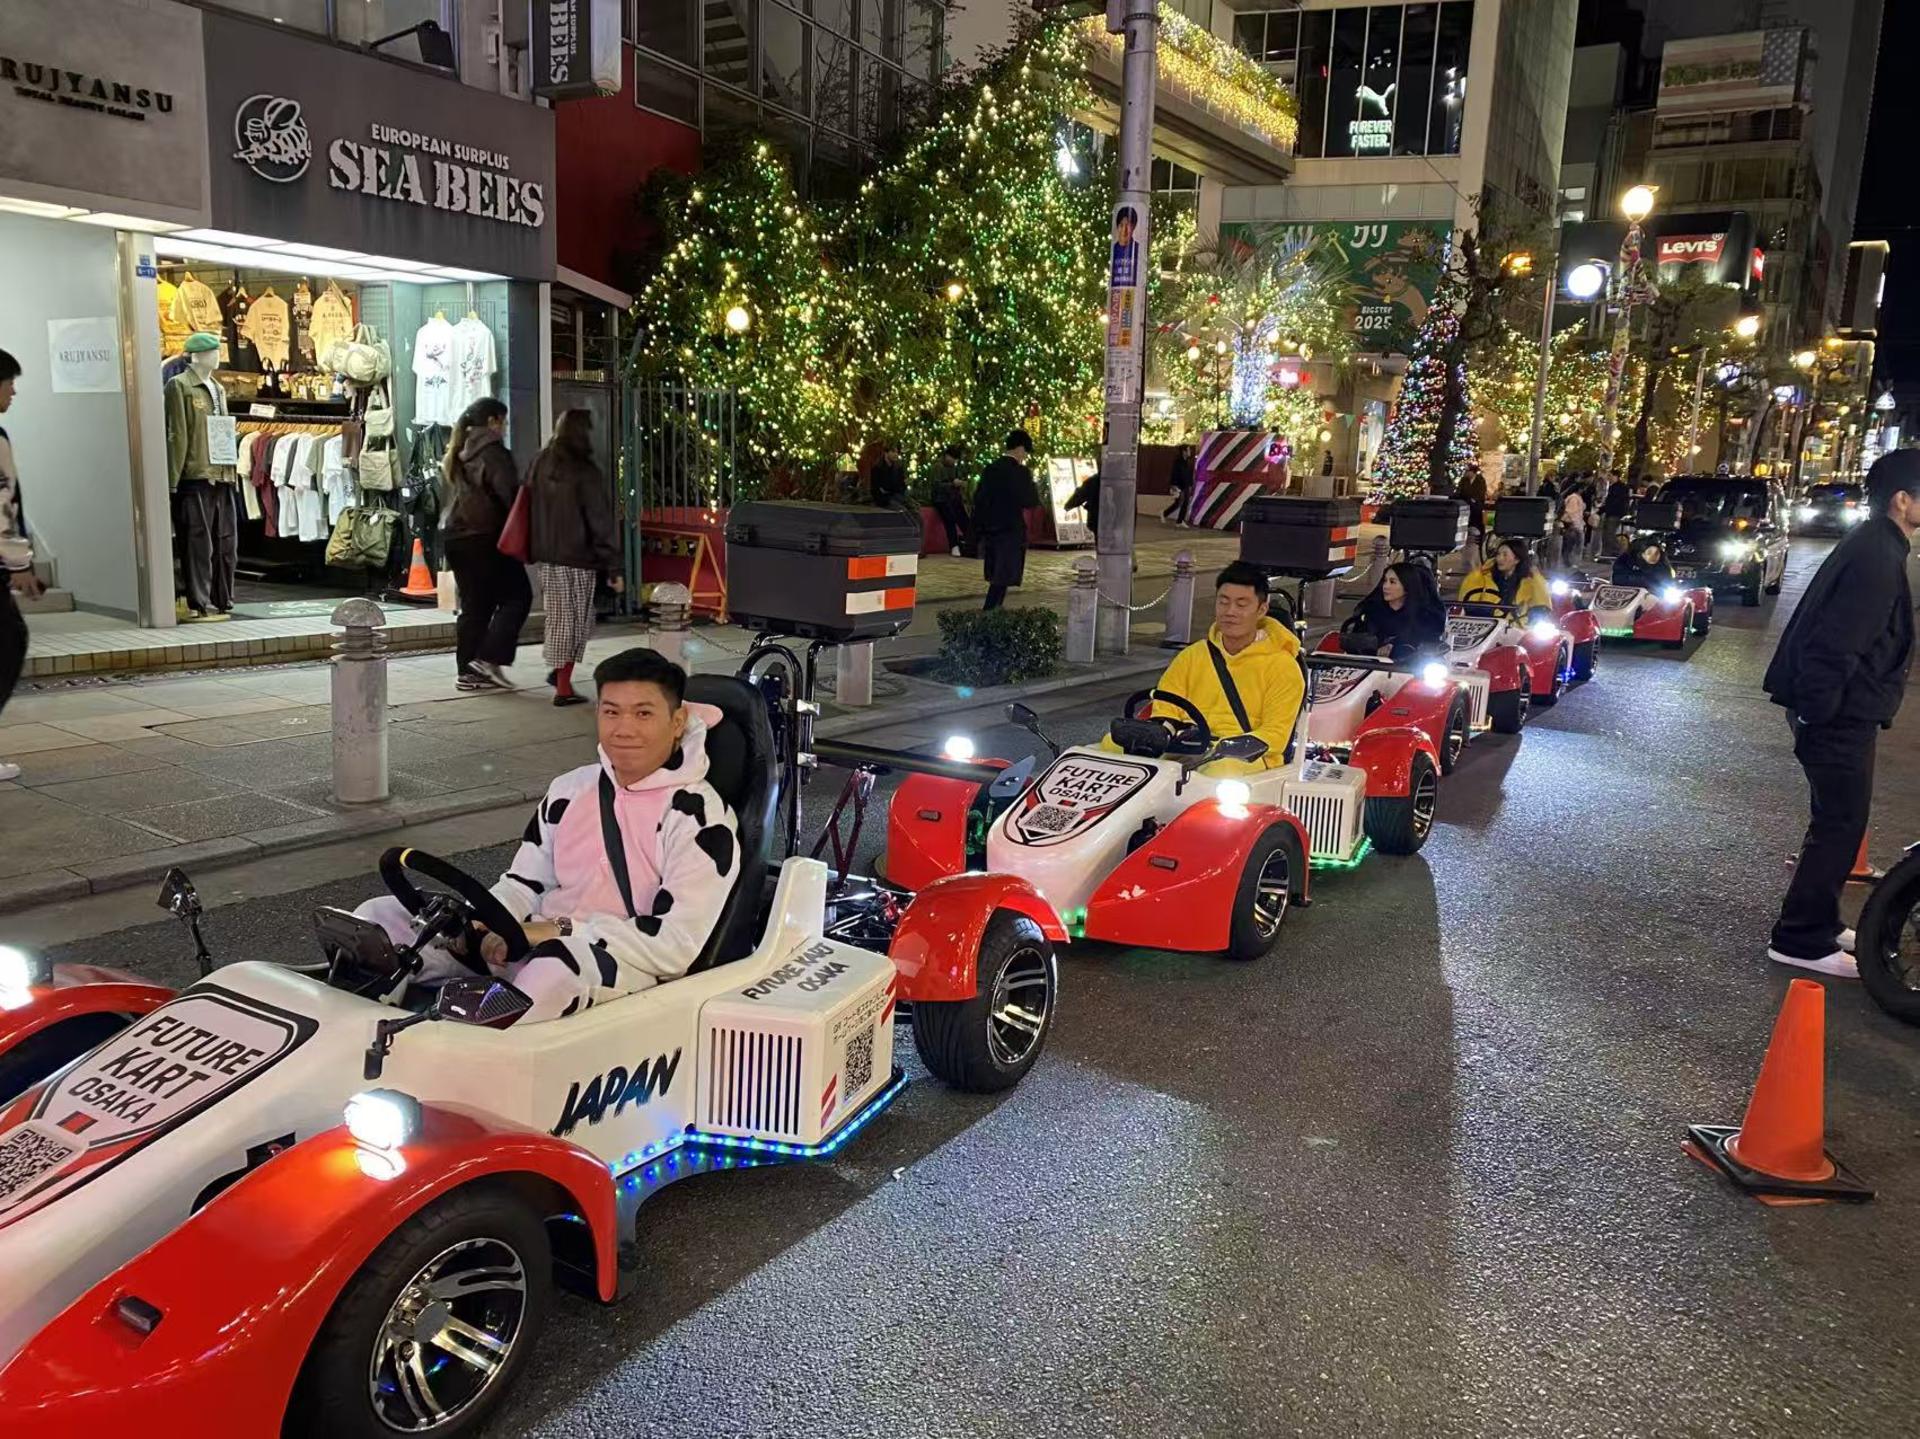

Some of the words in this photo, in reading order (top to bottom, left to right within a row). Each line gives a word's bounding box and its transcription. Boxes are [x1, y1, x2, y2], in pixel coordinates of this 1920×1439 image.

[0, 56, 173, 113] RUJYANSU
[1349, 120, 1392, 134] FOREVER
[1351, 133, 1391, 149] FASTER.
[371, 123, 451, 155] EUROPEAN
[453, 143, 510, 170] SURPLUS
[328, 138, 428, 206] SEA
[433, 160, 545, 228] BEES
[1354, 315, 1393, 330] 2025
[1055, 777, 1120, 795] KART
[1058, 765, 1139, 786] FUTURE
[1048, 787, 1102, 803] OSAKA
[741, 964, 805, 1000] FUTURE
[797, 962, 850, 992] OSAKA
[133, 1015, 265, 1076] FUTURE
[99, 1047, 210, 1099] KART
[67, 1077, 157, 1124] OSAKA
[551, 1047, 683, 1137] JAPAN
